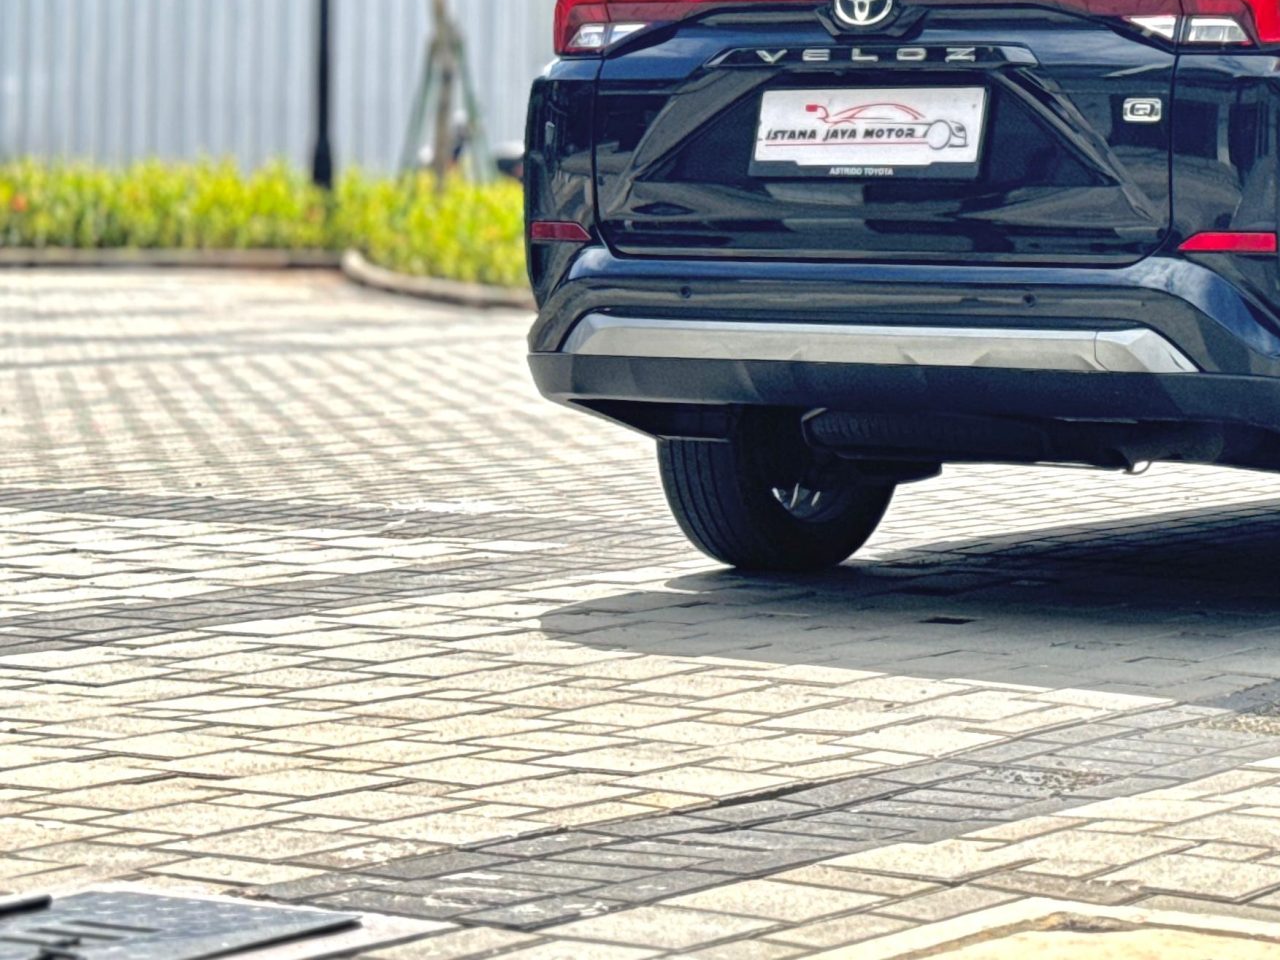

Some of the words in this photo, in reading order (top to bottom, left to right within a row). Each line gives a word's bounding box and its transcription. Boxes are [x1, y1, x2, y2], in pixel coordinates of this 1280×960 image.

[756, 48, 976, 63] VELOZ
[765, 128, 817, 140] ISTANA
[823, 128, 856, 141] JAYA
[863, 128, 915, 139] MOTOR
[829, 167, 862, 176] ASTRIDO
[863, 167, 893, 176] TOYOTA
